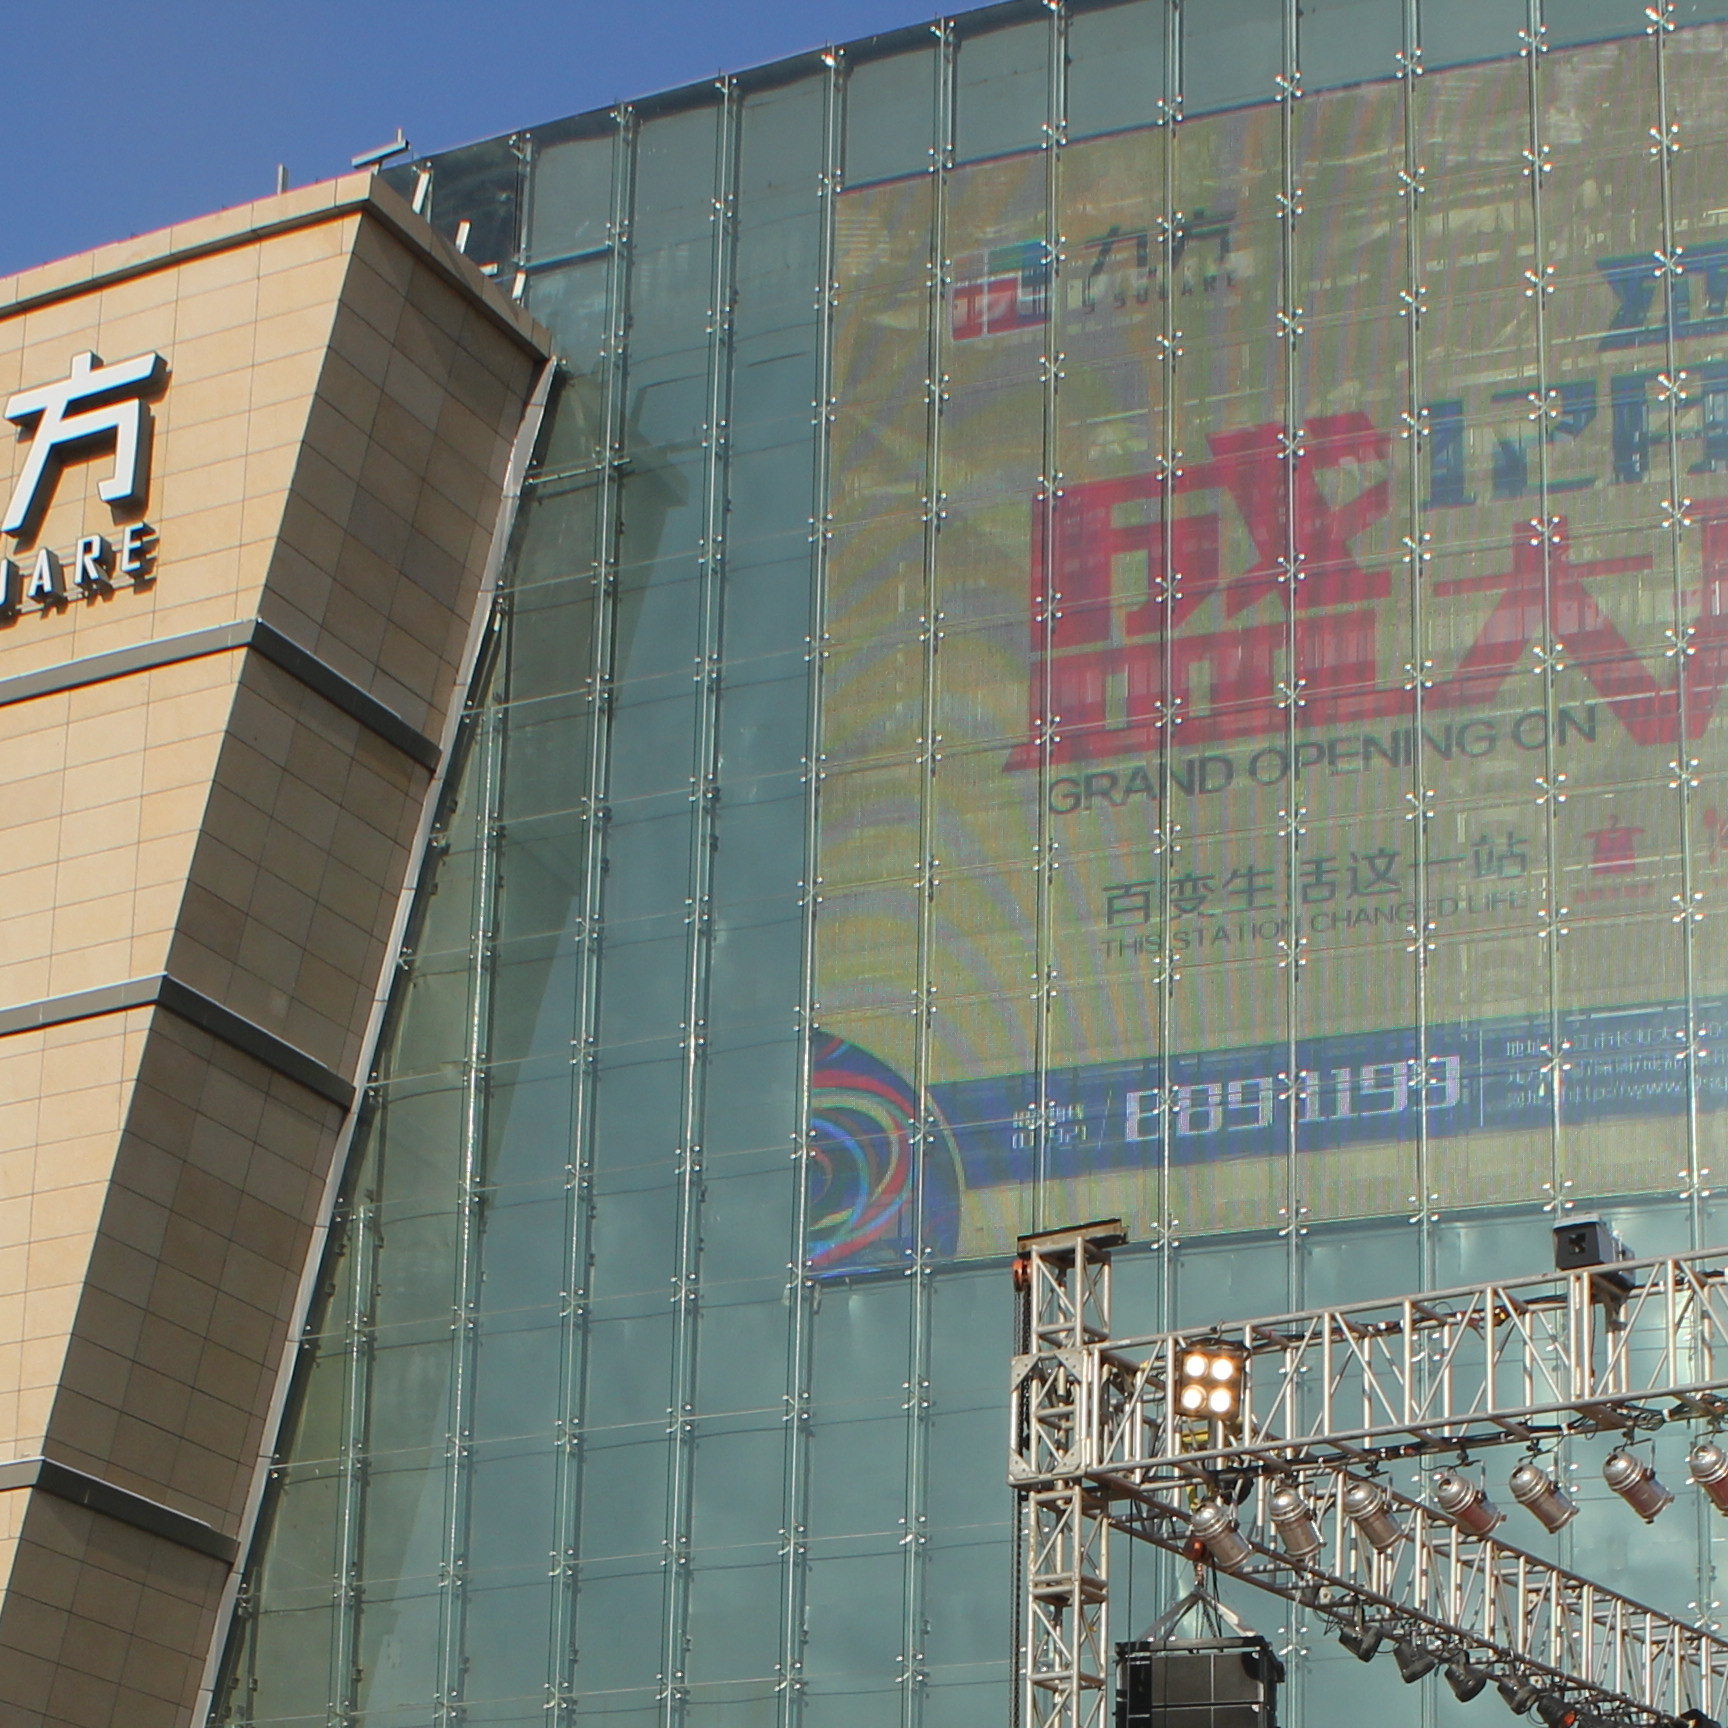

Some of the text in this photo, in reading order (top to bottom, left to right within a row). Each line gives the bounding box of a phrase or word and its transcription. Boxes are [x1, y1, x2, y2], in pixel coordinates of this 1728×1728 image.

[1085, 207, 1237, 276] 九方
[1045, 756, 1235, 818] GRAND
[1247, 716, 1500, 788] OPENING
[1510, 705, 1599, 754] ON
[1101, 831, 1529, 930] 百变生活这一站
[1101, 934, 1162, 960] THIS
[1309, 896, 1460, 934] CHANGED
